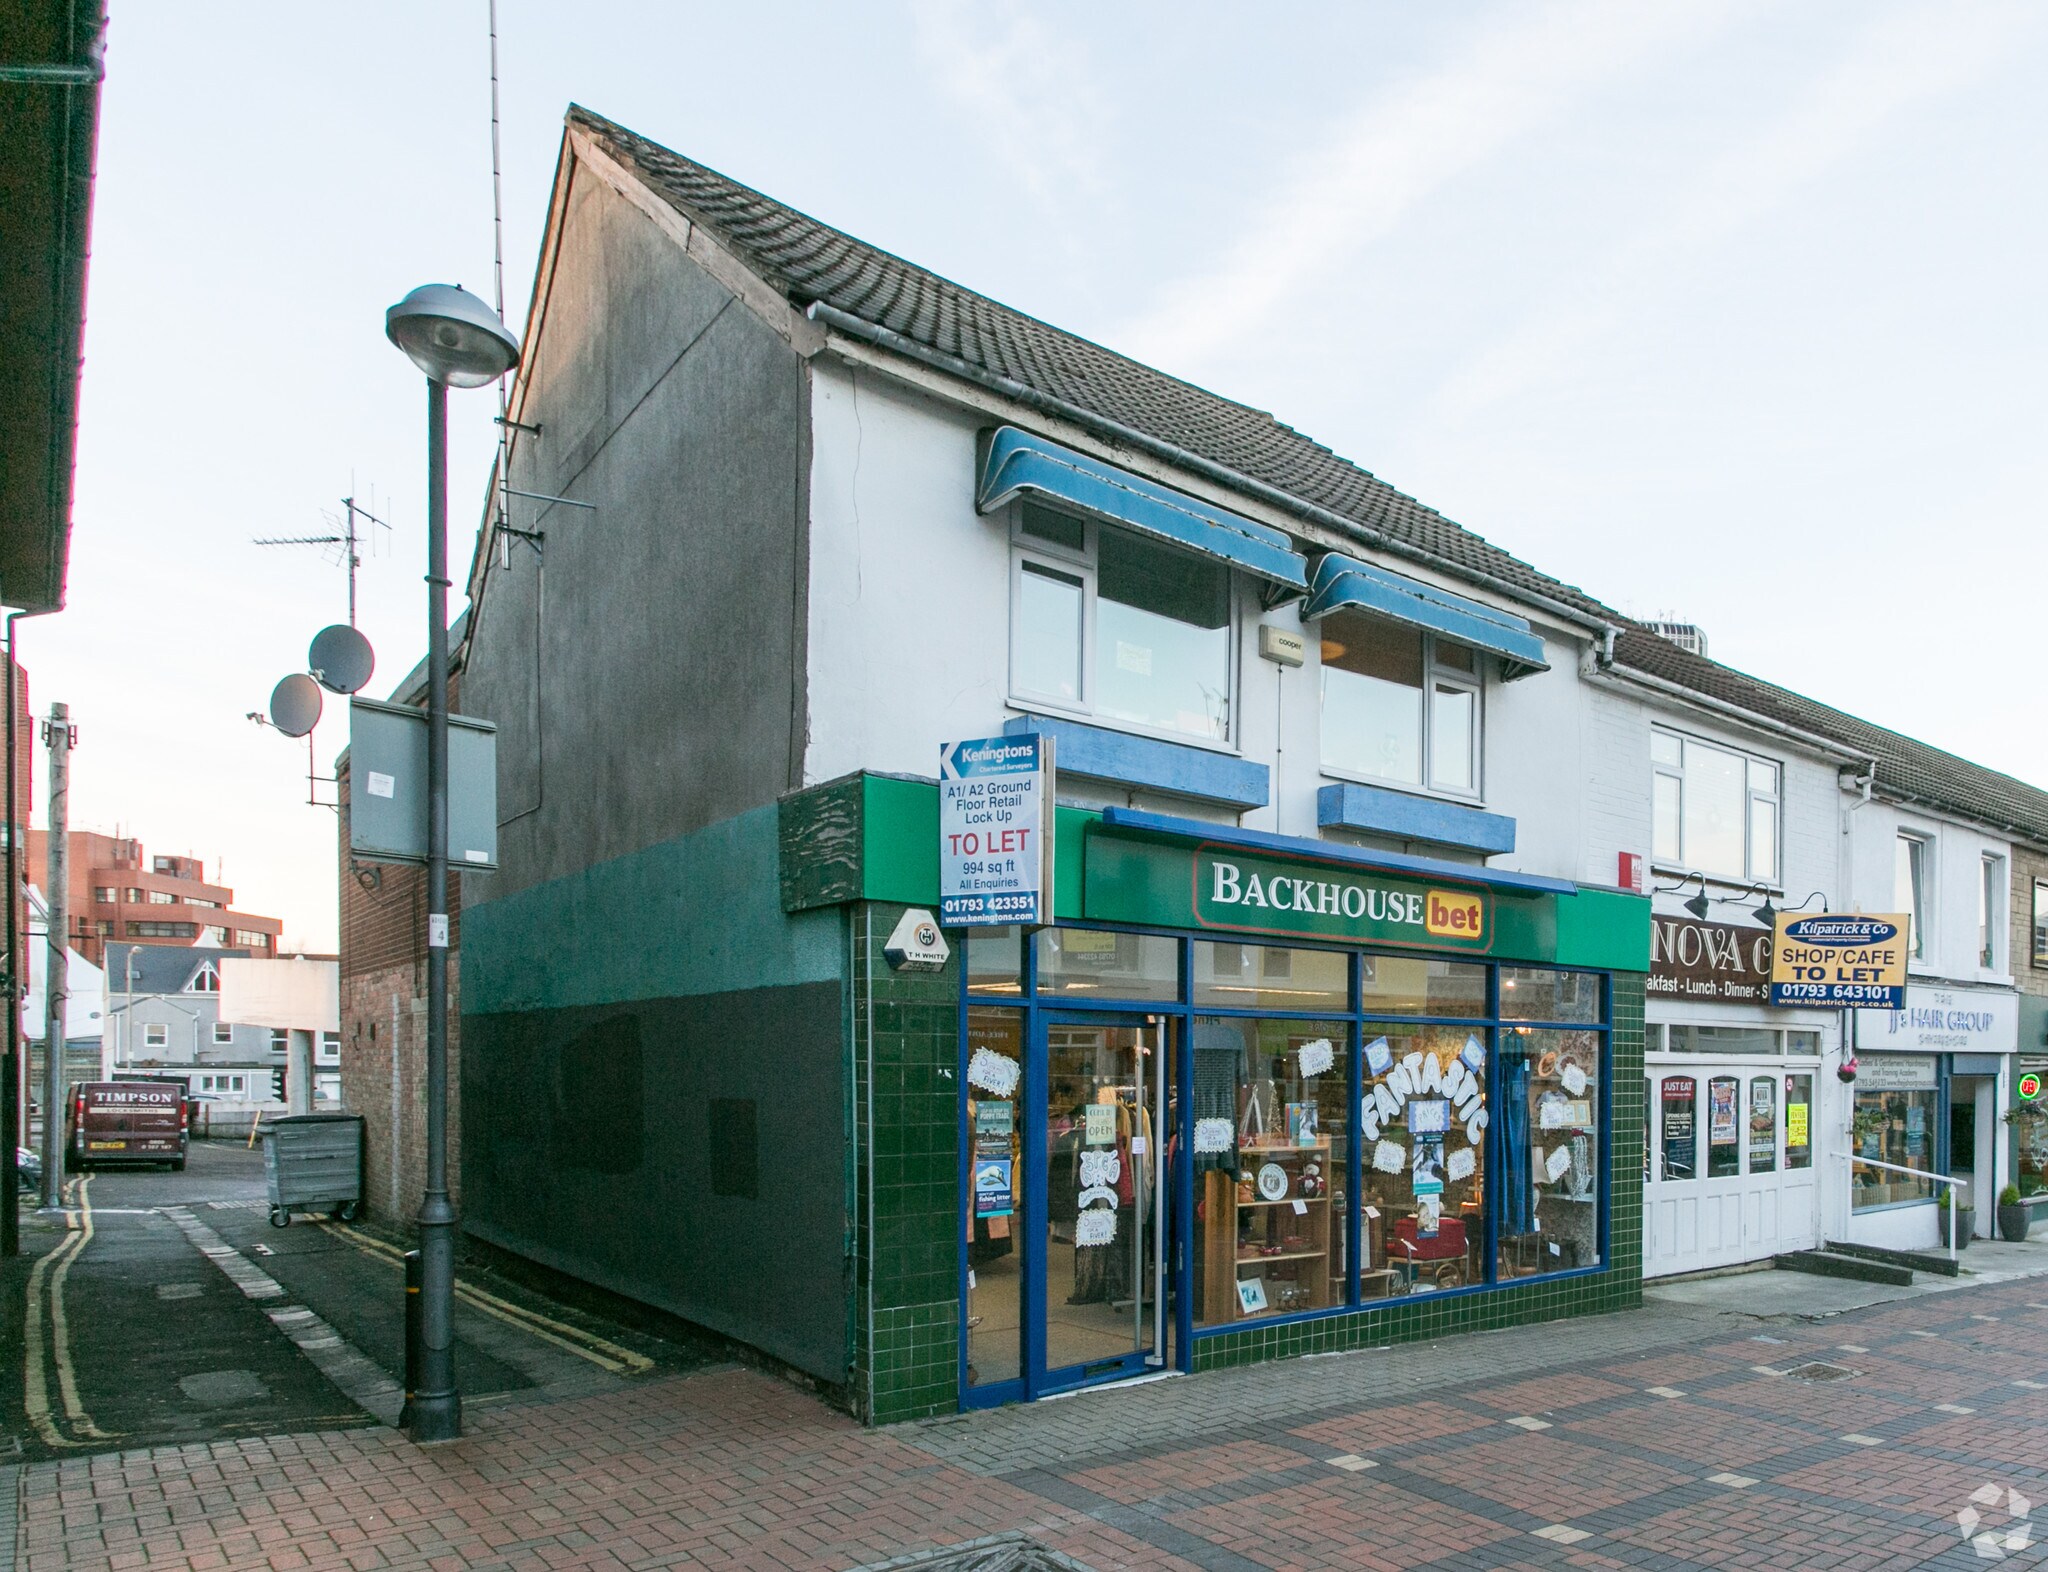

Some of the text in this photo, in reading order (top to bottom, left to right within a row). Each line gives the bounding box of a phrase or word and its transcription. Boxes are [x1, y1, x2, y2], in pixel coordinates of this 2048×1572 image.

[1279, 638, 1302, 650] cooper
[961, 744, 1034, 763] Keningtons
[979, 762, 1033, 773] Chartered Surveyors
[948, 779, 1031, 799] A1/ A2 Ground
[956, 794, 1022, 812] Floor Retail
[965, 809, 1012, 824] Lock Up
[948, 828, 1031, 856] TO LET
[963, 859, 1015, 875] 994 sq ft
[959, 878, 1019, 890] All Enquiries
[945, 896, 1035, 913] 01793 423351
[945, 912, 1034, 924] www.keningtons.com
[1430, 896, 1480, 931] bet
[1798, 922, 1889, 936] Kilpatrick & Co
[1650, 920, 1746, 973] NOVA
[1782, 948, 1895, 965] SHOP/CAFE
[1792, 966, 1885, 982] TO LET
[1686, 977, 1717, 996] Lunch
[1724, 981, 1755, 998] Dinner
[1782, 984, 1890, 999] 01793 643101
[1778, 997, 1894, 1008] www.kilpatrick-cpc.co.uk
[1911, 1008, 1944, 1029] HAIR
[1947, 1011, 1994, 1032] GROUP
[983, 1075, 1005, 1089] FIVER!
[1664, 1081, 1692, 1091] JUST EAT
[94, 1092, 173, 1103] TIMPSON
[1361, 1052, 1489, 1145] FANTASTIC
[1089, 1125, 1113, 1136] OPEN
[1090, 1231, 1107, 1240] FIVER!
